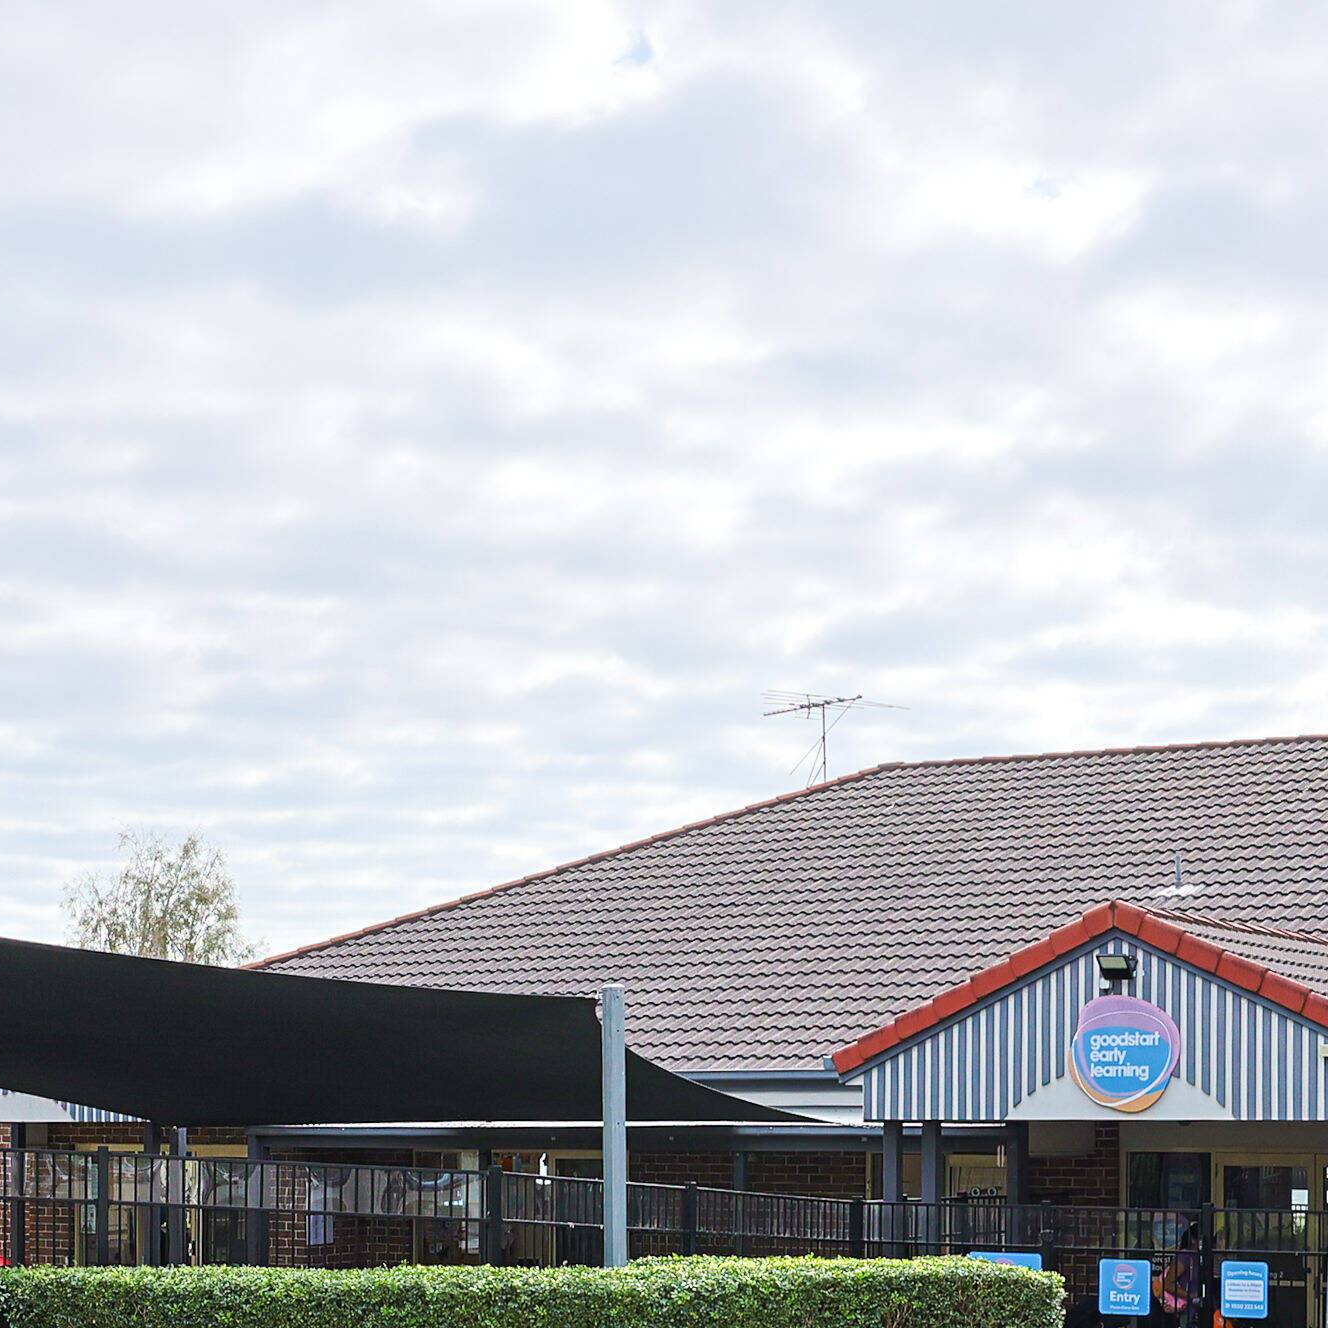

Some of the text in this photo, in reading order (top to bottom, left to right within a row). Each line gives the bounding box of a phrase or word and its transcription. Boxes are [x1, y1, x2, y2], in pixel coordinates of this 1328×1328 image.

[1090, 1031, 1161, 1050] goodstart
[1090, 1047, 1127, 1065] early
[1090, 1063, 1149, 1081] learning
[1109, 1290, 1141, 1306] Entry
